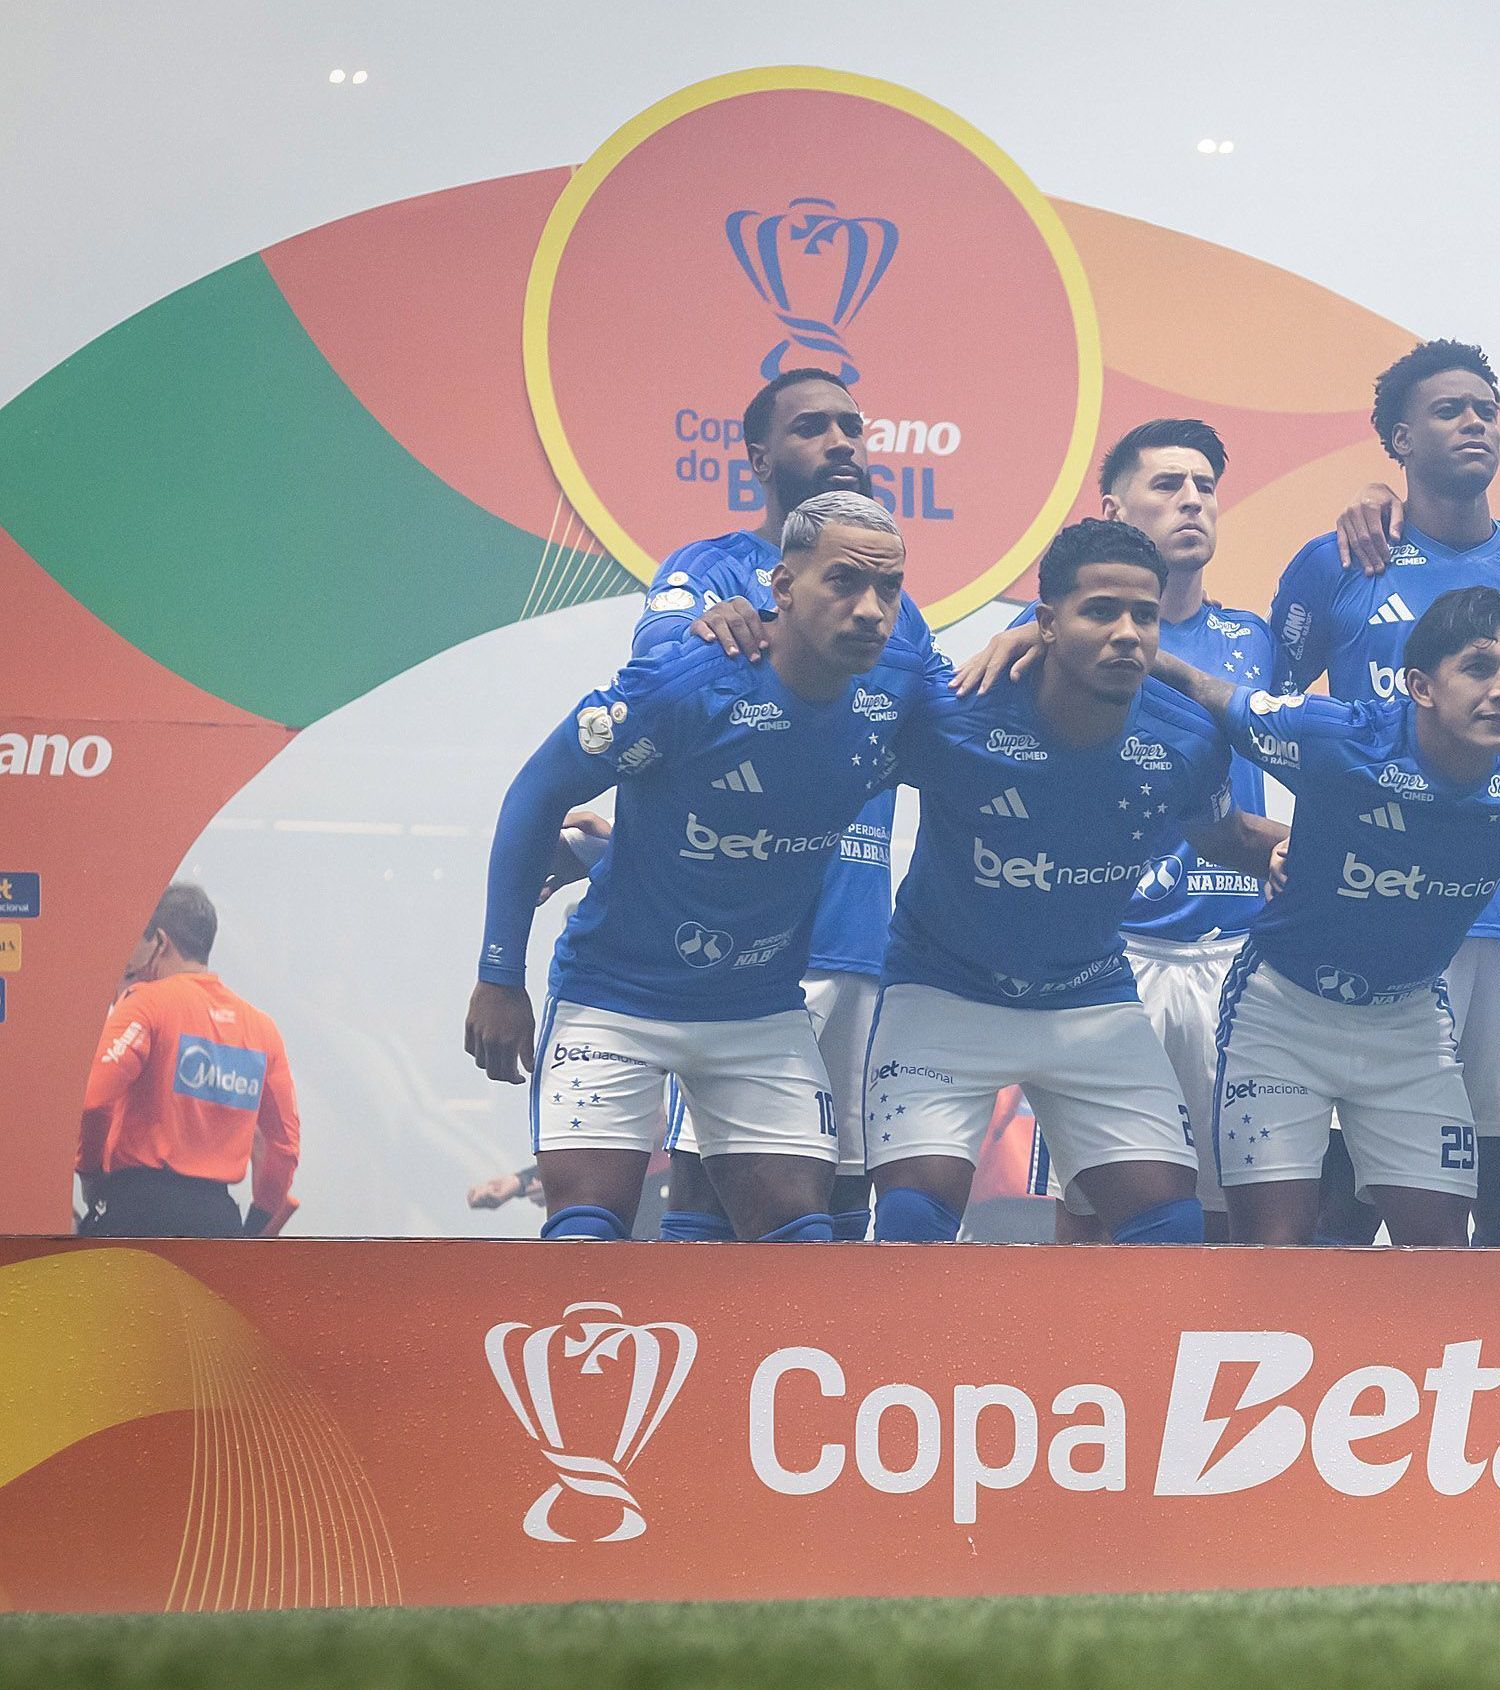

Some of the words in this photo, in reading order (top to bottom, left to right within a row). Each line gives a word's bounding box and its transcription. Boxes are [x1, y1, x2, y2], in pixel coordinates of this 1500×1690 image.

[675, 408, 744, 450] Cop
[862, 411, 961, 456] ano
[675, 450, 720, 482] do
[728, 459, 954, 520] BSIL
[1396, 556, 1427, 566] CIMED
[730, 700, 783, 727] Super
[852, 687, 893, 715] Super
[757, 720, 791, 731] CIMED
[869, 710, 898, 722] CIMED
[986, 728, 1040, 755] Super
[1120, 736, 1167, 765] Super
[1014, 750, 1048, 761] CIMED
[1142, 762, 1173, 771] CIMED
[1379, 764, 1429, 791] Super
[1402, 791, 1435, 802] CIMED
[680, 812, 774, 861] bet
[774, 830, 840, 853] nacio
[848, 823, 890, 840] PERDIGÃ
[840, 839, 861, 858] NA
[973, 837, 1055, 891] bet
[1337, 852, 1427, 899] bet
[1426, 876, 1497, 897] nacio
[1187, 874, 1216, 891] NA
[1215, 876, 1259, 892] BRASA
[551, 1043, 591, 1069] bet
[192, 1060, 260, 1097] Midea
[899, 1064, 954, 1085] nacional
[1224, 1080, 1257, 1108] bet
[1257, 1083, 1309, 1095] nacional
[815, 1090, 837, 1138] 10
[1441, 1125, 1475, 1169] 29
[749, 1346, 1127, 1525] Copa
